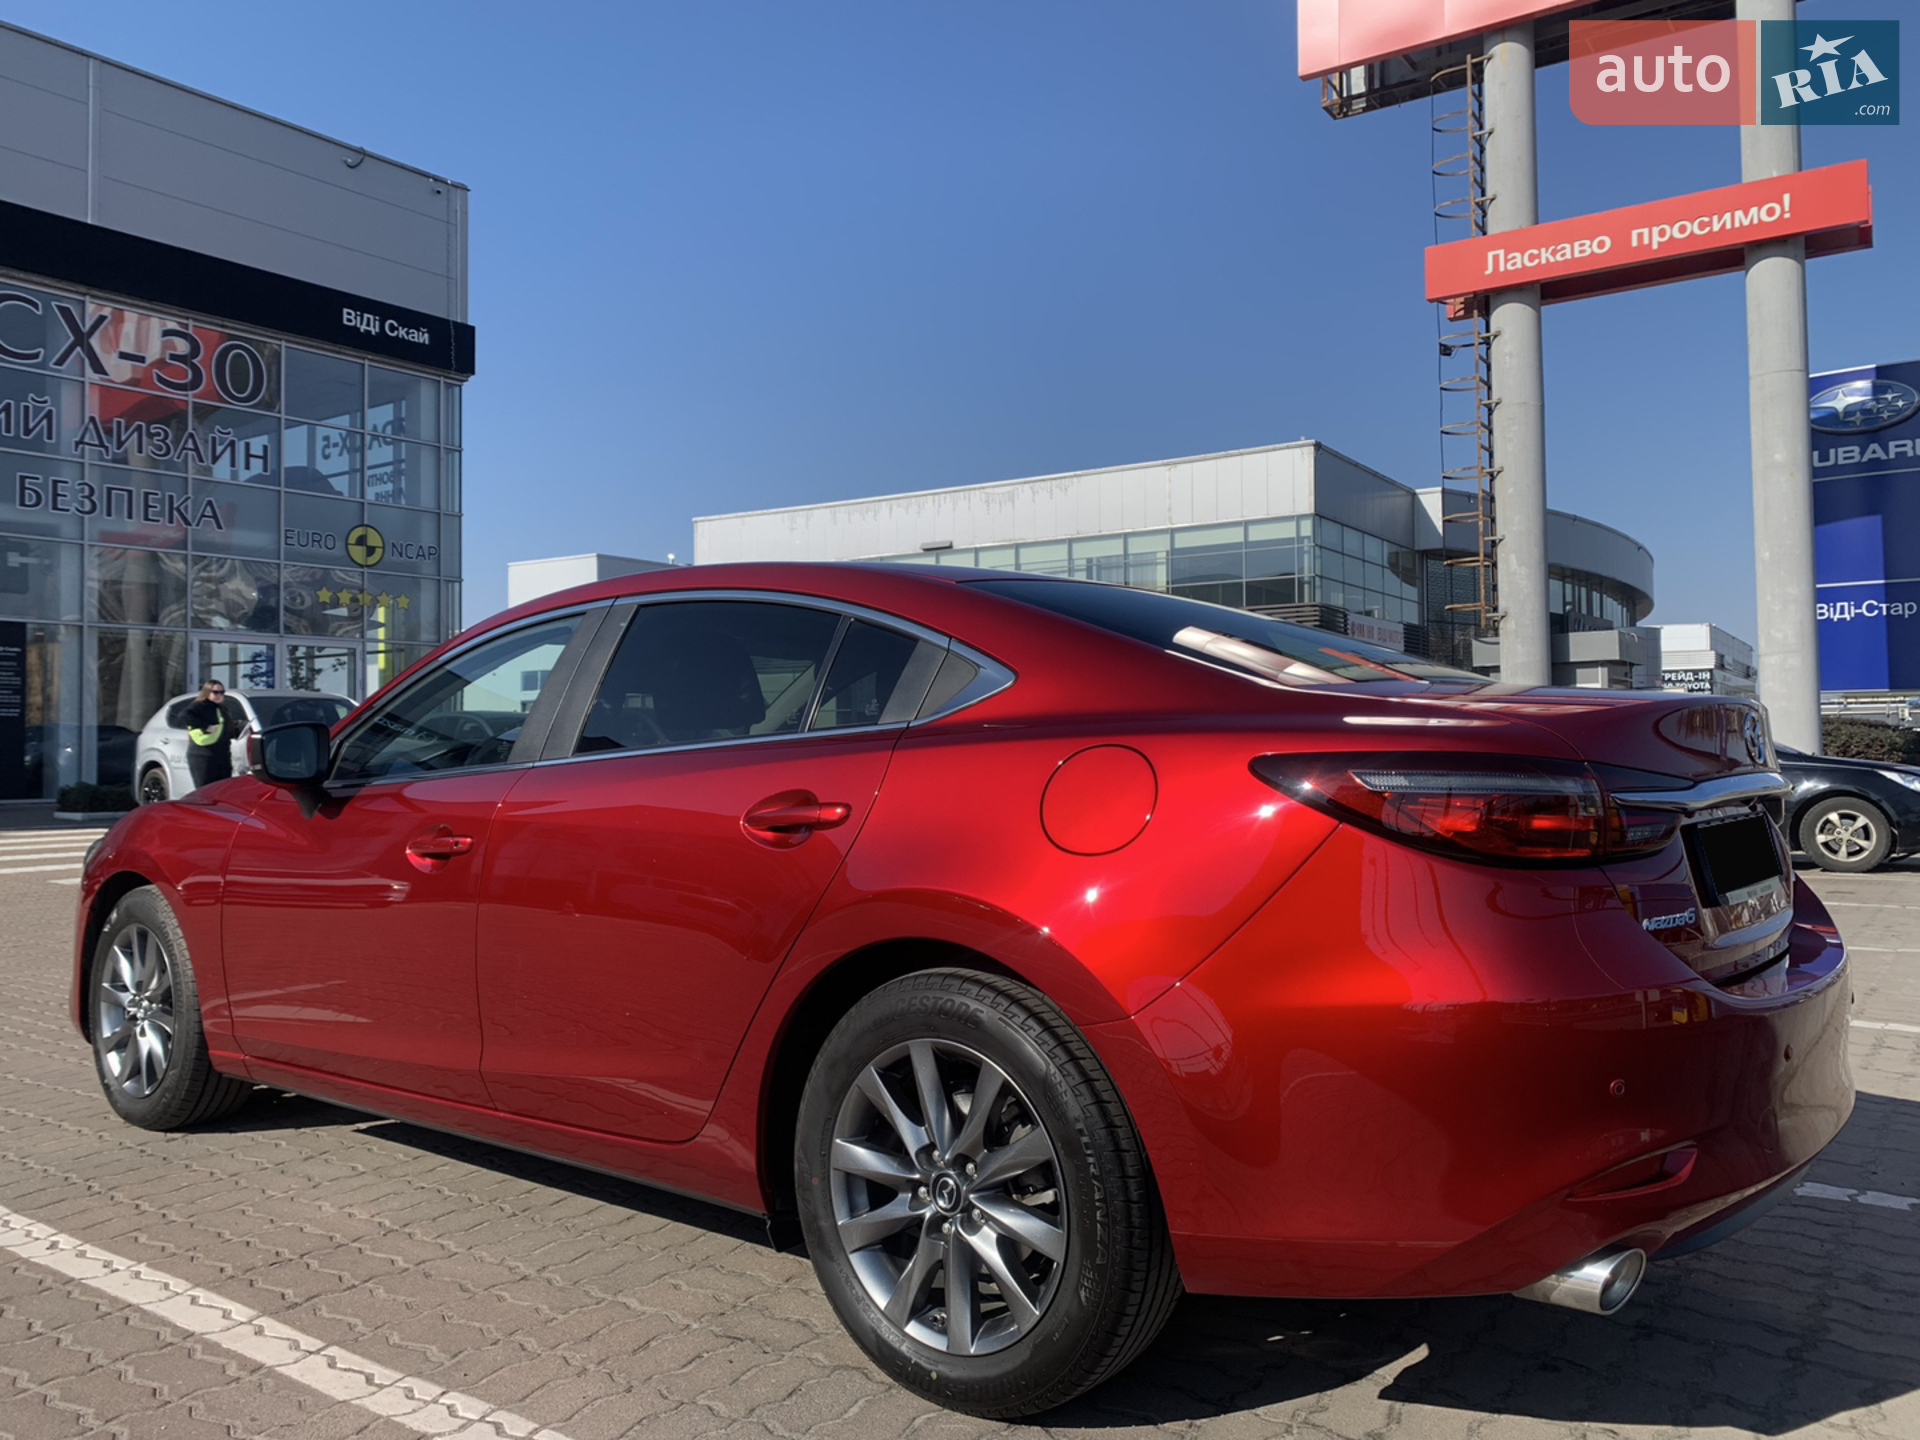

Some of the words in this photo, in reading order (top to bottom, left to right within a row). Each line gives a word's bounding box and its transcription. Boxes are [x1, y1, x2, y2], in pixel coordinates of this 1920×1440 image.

[1484, 235, 1612, 275] Ласкаво
[1631, 193, 1792, 249] просимо!
[342, 308, 380, 336] ВіДі
[384, 319, 430, 345] Скай
[72, 415, 270, 475] ДИЗАЙН
[1812, 438, 1920, 467] UBAR
[16, 473, 225, 531] БЕЗПЕКА
[284, 528, 337, 551] EURO
[390, 541, 439, 562] NCAP
[1074, 1120, 1108, 1265] TURANZA
